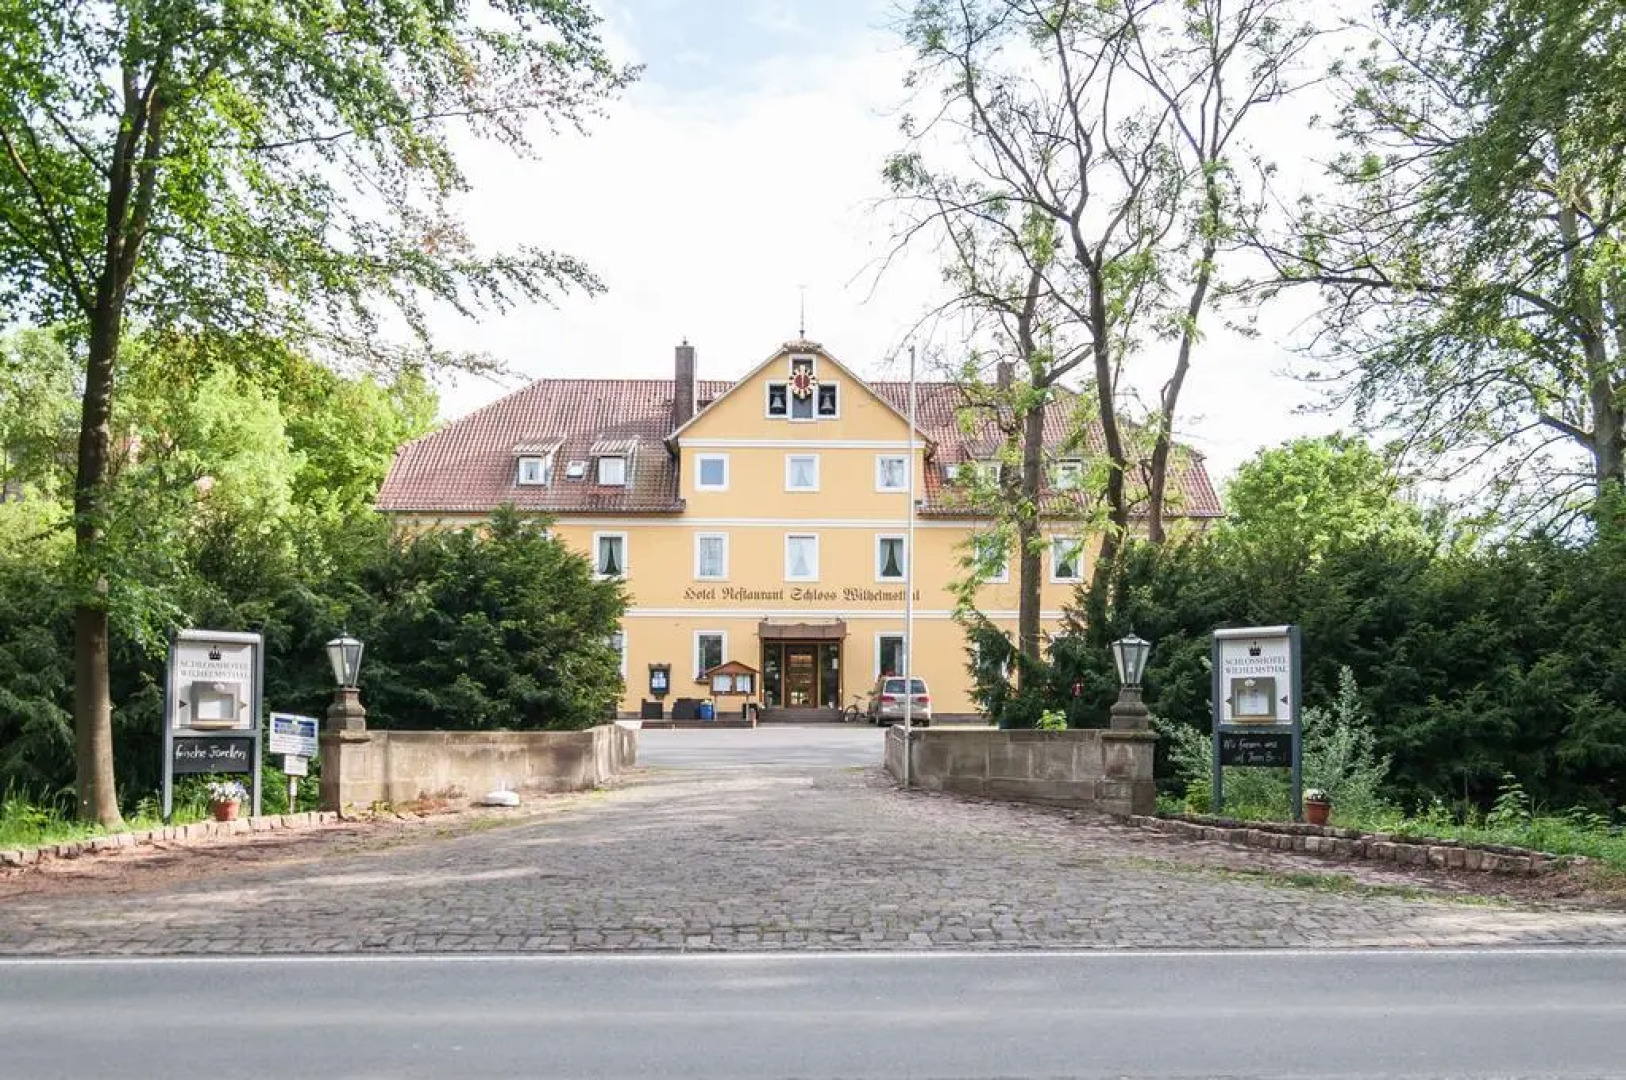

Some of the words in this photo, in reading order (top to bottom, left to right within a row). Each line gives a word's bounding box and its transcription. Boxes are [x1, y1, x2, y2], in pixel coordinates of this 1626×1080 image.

[684, 587, 716, 600] Hotel
[722, 587, 784, 600] Restaurant
[790, 587, 838, 603] Schloss
